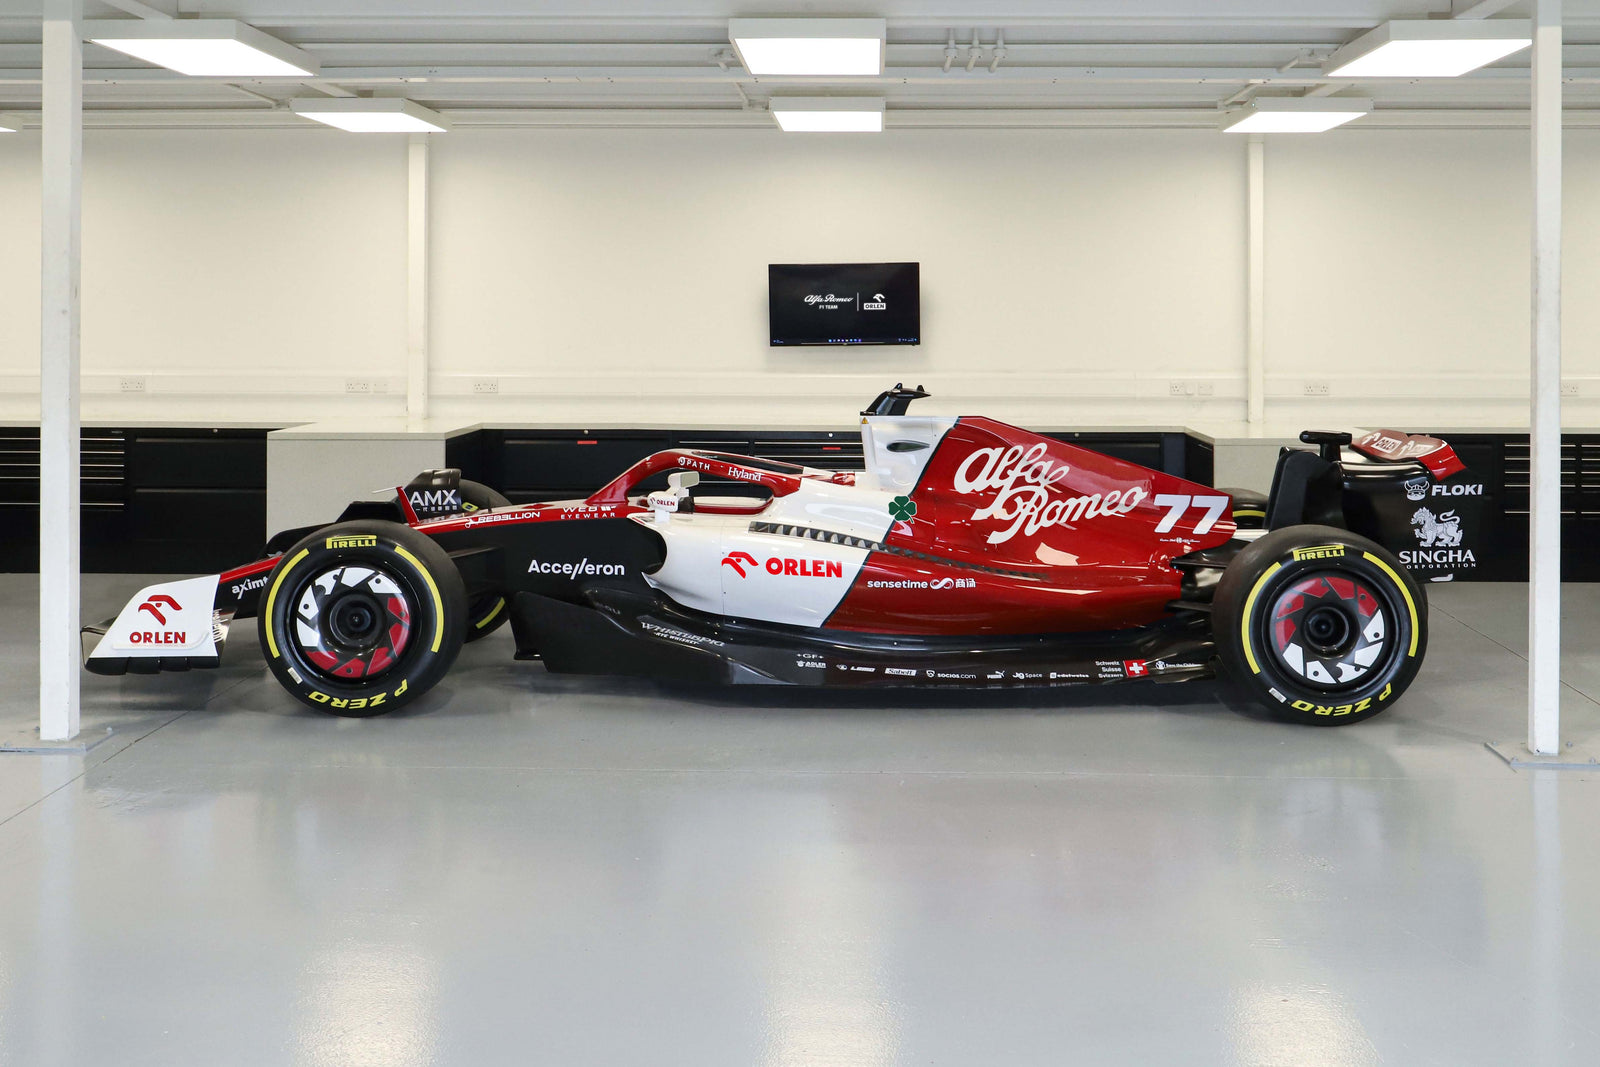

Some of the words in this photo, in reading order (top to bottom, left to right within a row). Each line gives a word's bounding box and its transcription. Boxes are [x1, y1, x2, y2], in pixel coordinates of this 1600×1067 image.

[804, 294, 823, 306] Alfa
[824, 293, 854, 303] Romeo
[727, 466, 763, 482] Hyland
[954, 443, 1070, 521] Alfa
[409, 489, 457, 507] AMX
[1431, 484, 1483, 496] FLOKI
[656, 499, 676, 507] ORLEN
[560, 512, 616, 520] EYEWEAR
[986, 485, 1148, 544] Romeo
[1153, 494, 1229, 535] 77
[326, 534, 377, 550] PIRELLI
[1292, 544, 1345, 562] PIRELLI
[1398, 549, 1476, 564] SINGHA
[527, 557, 625, 580] Accelleron
[765, 557, 843, 578] ORLEN
[1406, 562, 1477, 570] ORPORATION
[867, 579, 928, 589] sensetime
[129, 631, 186, 644] ORLEN
[394, 678, 408, 697] P
[1378, 682, 1392, 701] P
[308, 690, 387, 710] ZERO
[1290, 697, 1372, 716] ZERO
